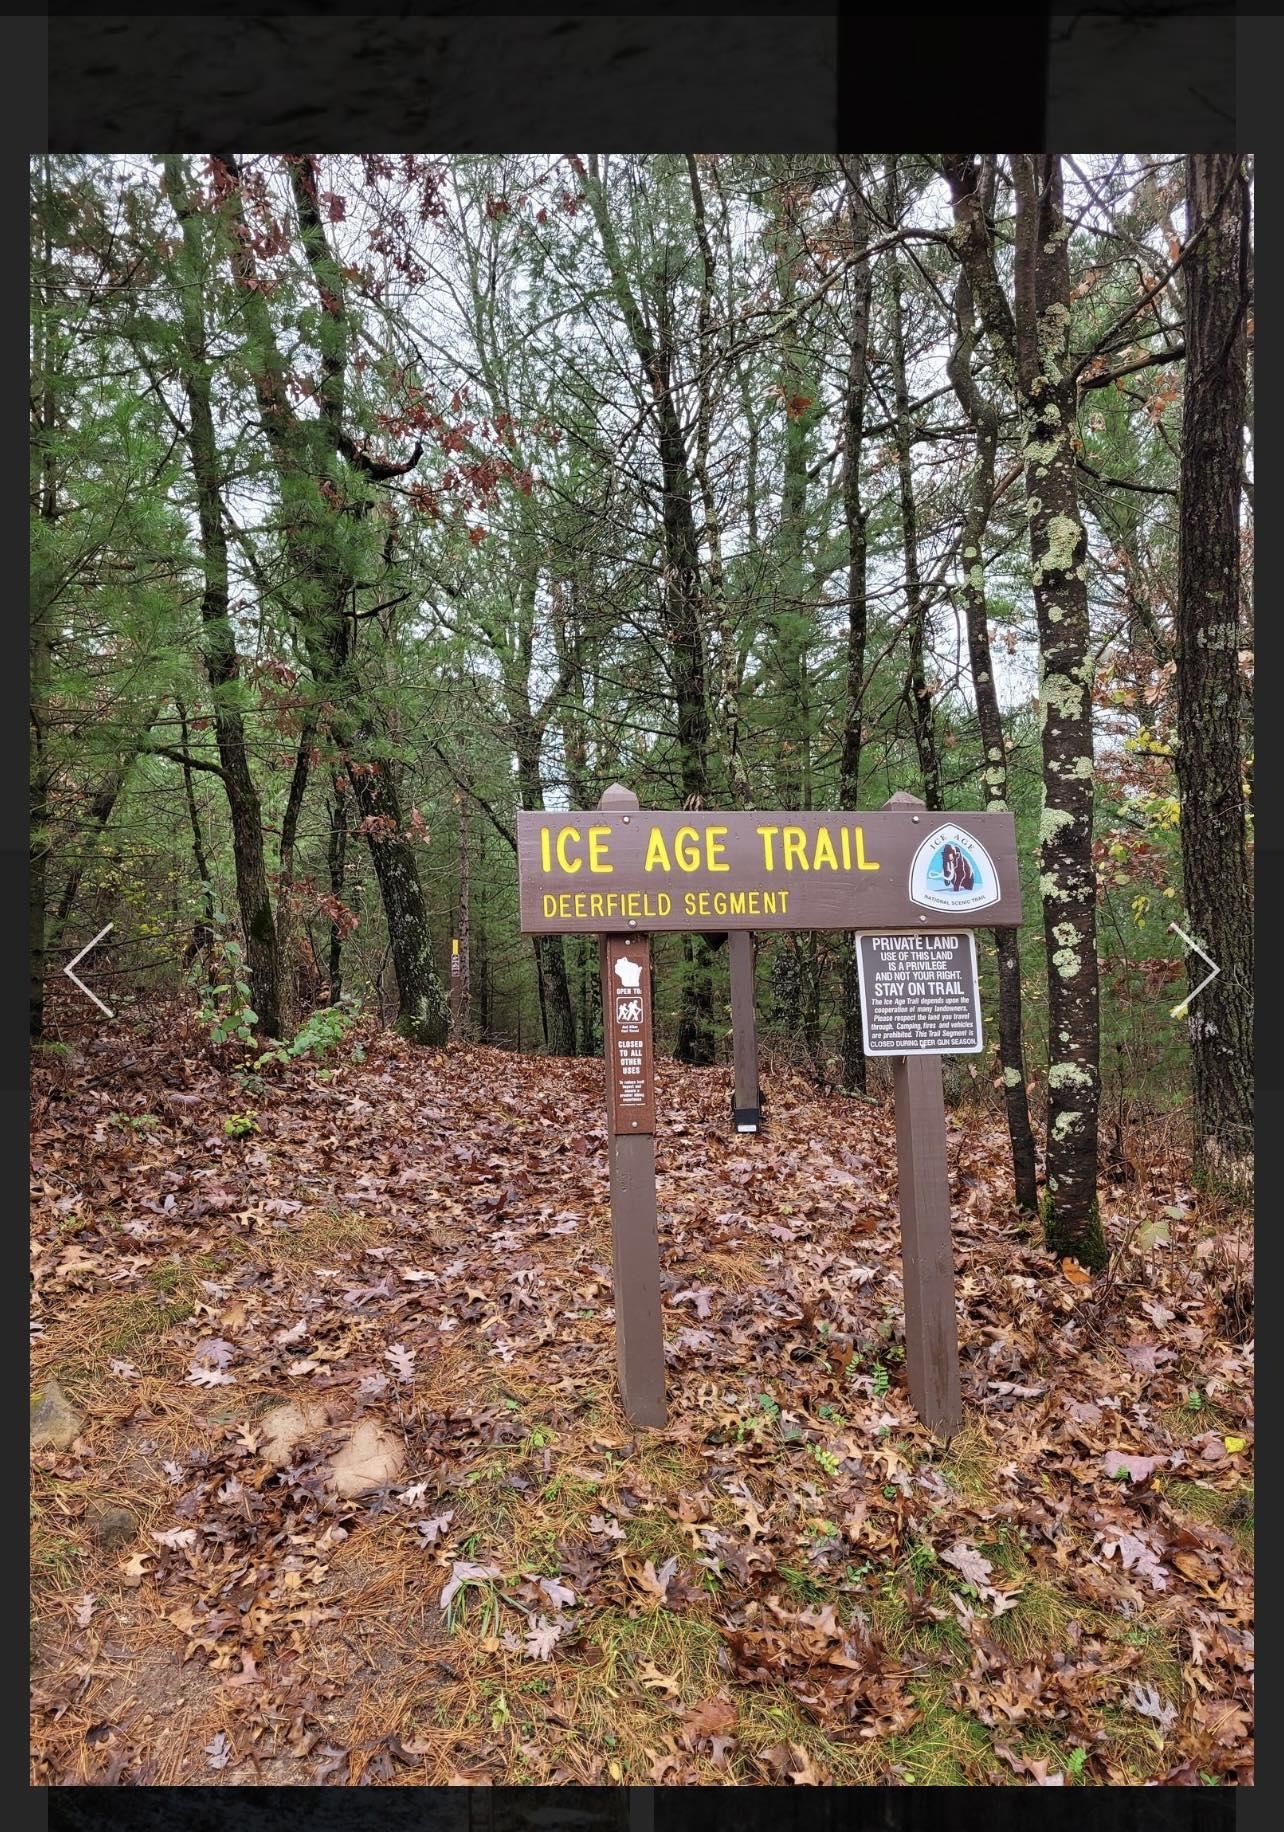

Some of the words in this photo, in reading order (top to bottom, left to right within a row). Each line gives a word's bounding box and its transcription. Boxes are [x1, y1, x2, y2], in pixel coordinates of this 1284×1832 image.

[930, 834, 947, 852] ICE
[954, 834, 975, 852] AGE
[540, 826, 614, 873] ICE
[645, 826, 731, 872] AGE
[757, 826, 880, 872] TRAIL
[542, 892, 672, 918] DEERFIELD
[684, 891, 789, 915] SEGMENT
[924, 895, 949, 906] NATIONAL
[952, 898, 971, 906] SCENIC
[972, 895, 986, 904] TRAIL
[873, 937, 923, 950] PRIVATE
[926, 936, 958, 950] LAND
[880, 952, 897, 961] USE
[898, 952, 908, 961] OF
[911, 952, 929, 961] THIS
[931, 951, 953, 960] LAND
[888, 962, 896, 971] IS
[898, 962, 905, 970] A
[906, 961, 947, 970] PRIVILEGE
[875, 972, 892, 981] AND
[894, 972, 910, 981] NOT
[913, 971, 936, 980] YOUR
[938, 970, 962, 980] RIGHT.
[875, 983, 904, 996] STAY
[908, 982, 925, 996] ON
[927, 982, 964, 995] TRAIL
[894, 998, 906, 1006] Age
[921, 997, 944, 1005] depends
[894, 1014, 916, 1022] respect
[942, 1030, 967, 1038] Segment
[620, 1058, 641, 1066] OTHER
